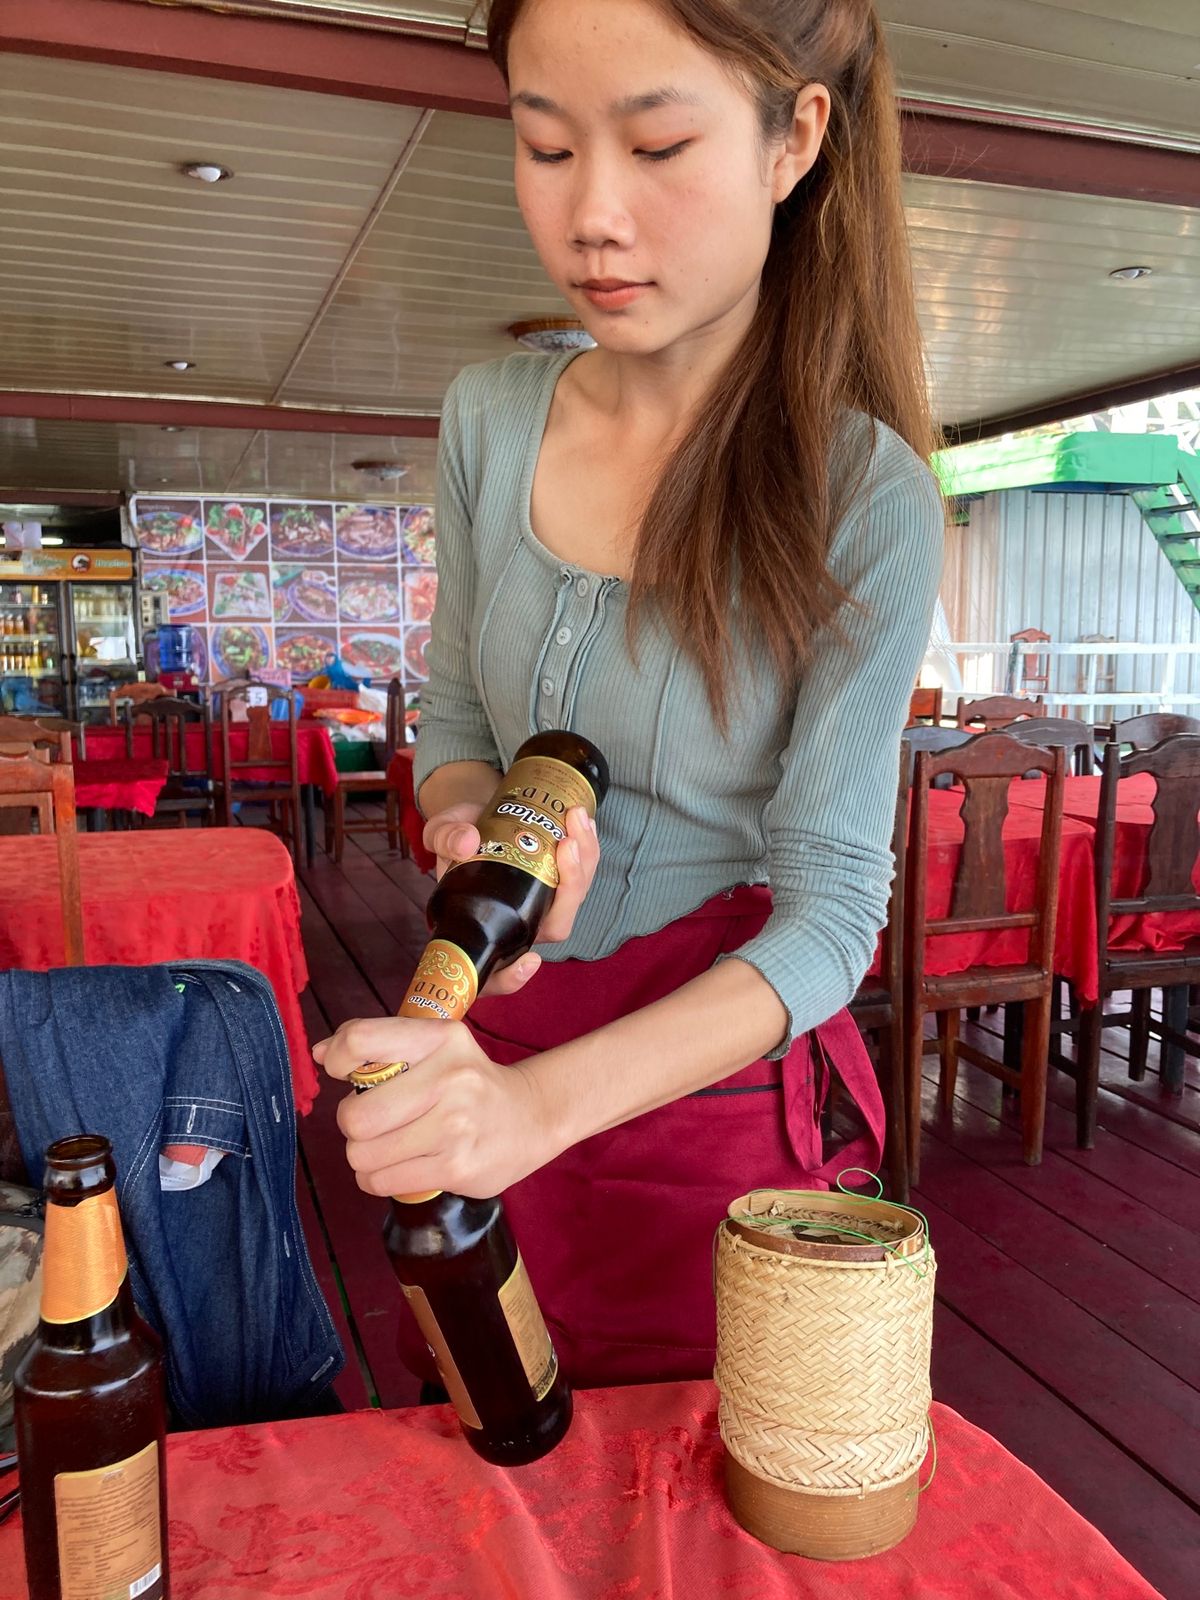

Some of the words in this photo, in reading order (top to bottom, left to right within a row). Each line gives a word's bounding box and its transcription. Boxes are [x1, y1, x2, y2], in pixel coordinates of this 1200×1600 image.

[522, 787, 565, 813] OLD
[497, 803, 567, 841] eerlao
[414, 981, 457, 1008] GOLD
